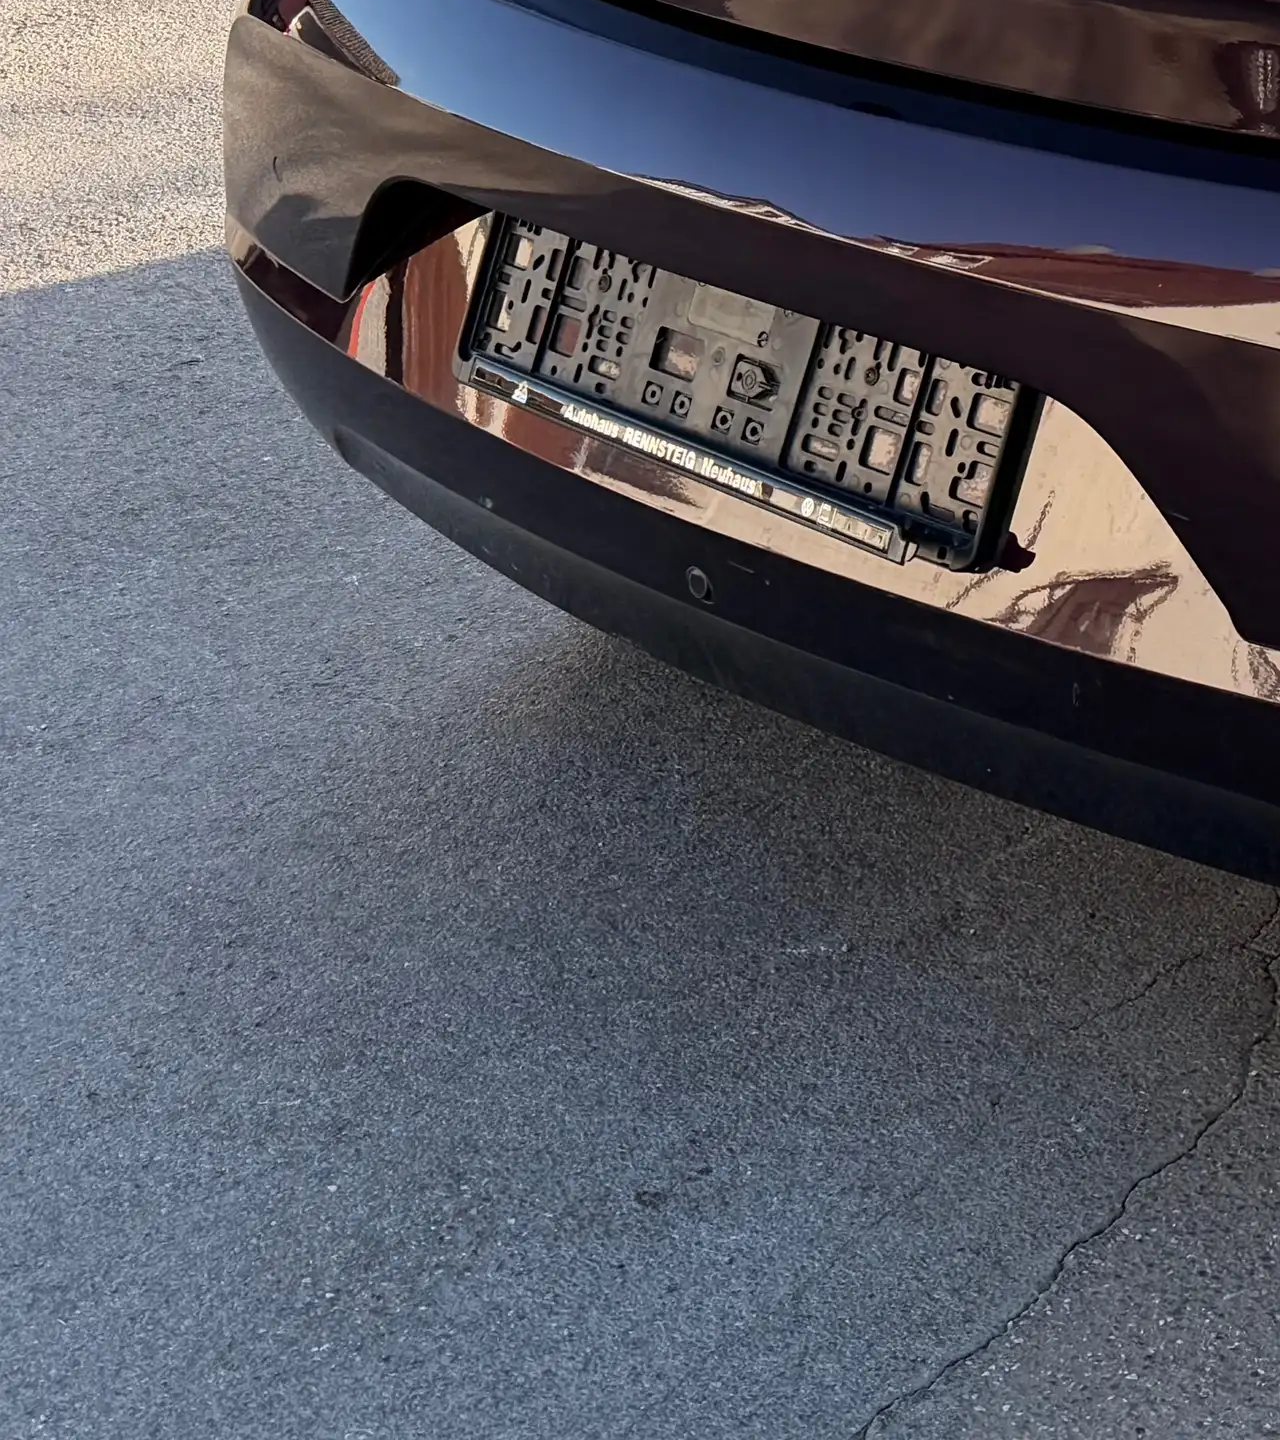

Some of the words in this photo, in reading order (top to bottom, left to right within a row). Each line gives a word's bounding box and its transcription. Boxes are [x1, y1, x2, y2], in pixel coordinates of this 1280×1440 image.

[563, 403, 620, 439] Autohaus
[623, 428, 697, 471] RENNSTEIG
[700, 457, 758, 495] Neuhaus
